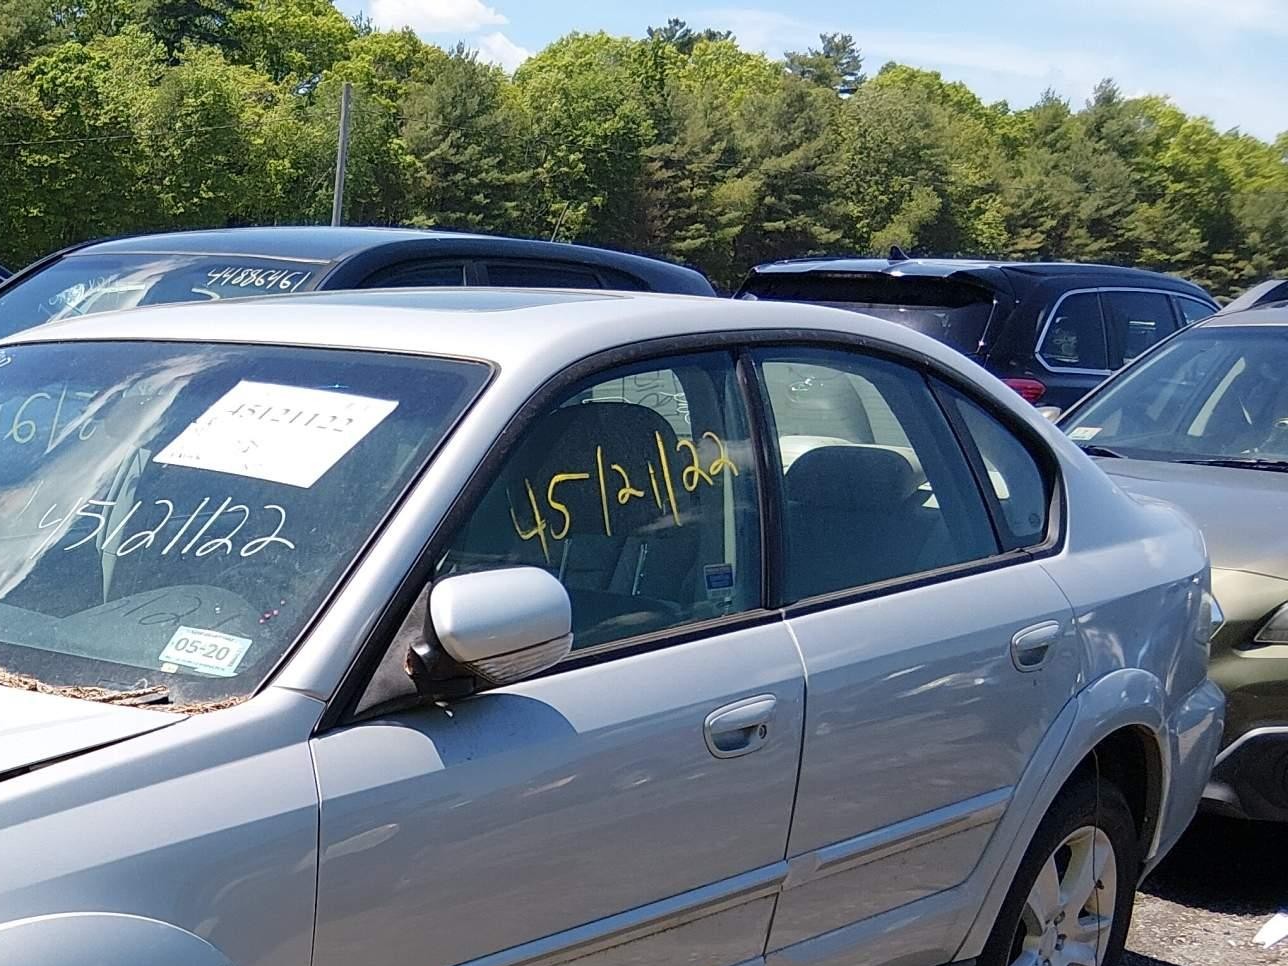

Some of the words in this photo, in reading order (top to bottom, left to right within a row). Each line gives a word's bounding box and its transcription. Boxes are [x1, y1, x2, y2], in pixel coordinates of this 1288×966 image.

[207, 267, 311, 293] 44886461
[506, 431, 738, 564] 45121122
[31, 496, 295, 560] 45121122
[174, 637, 231, 661] 05-20
